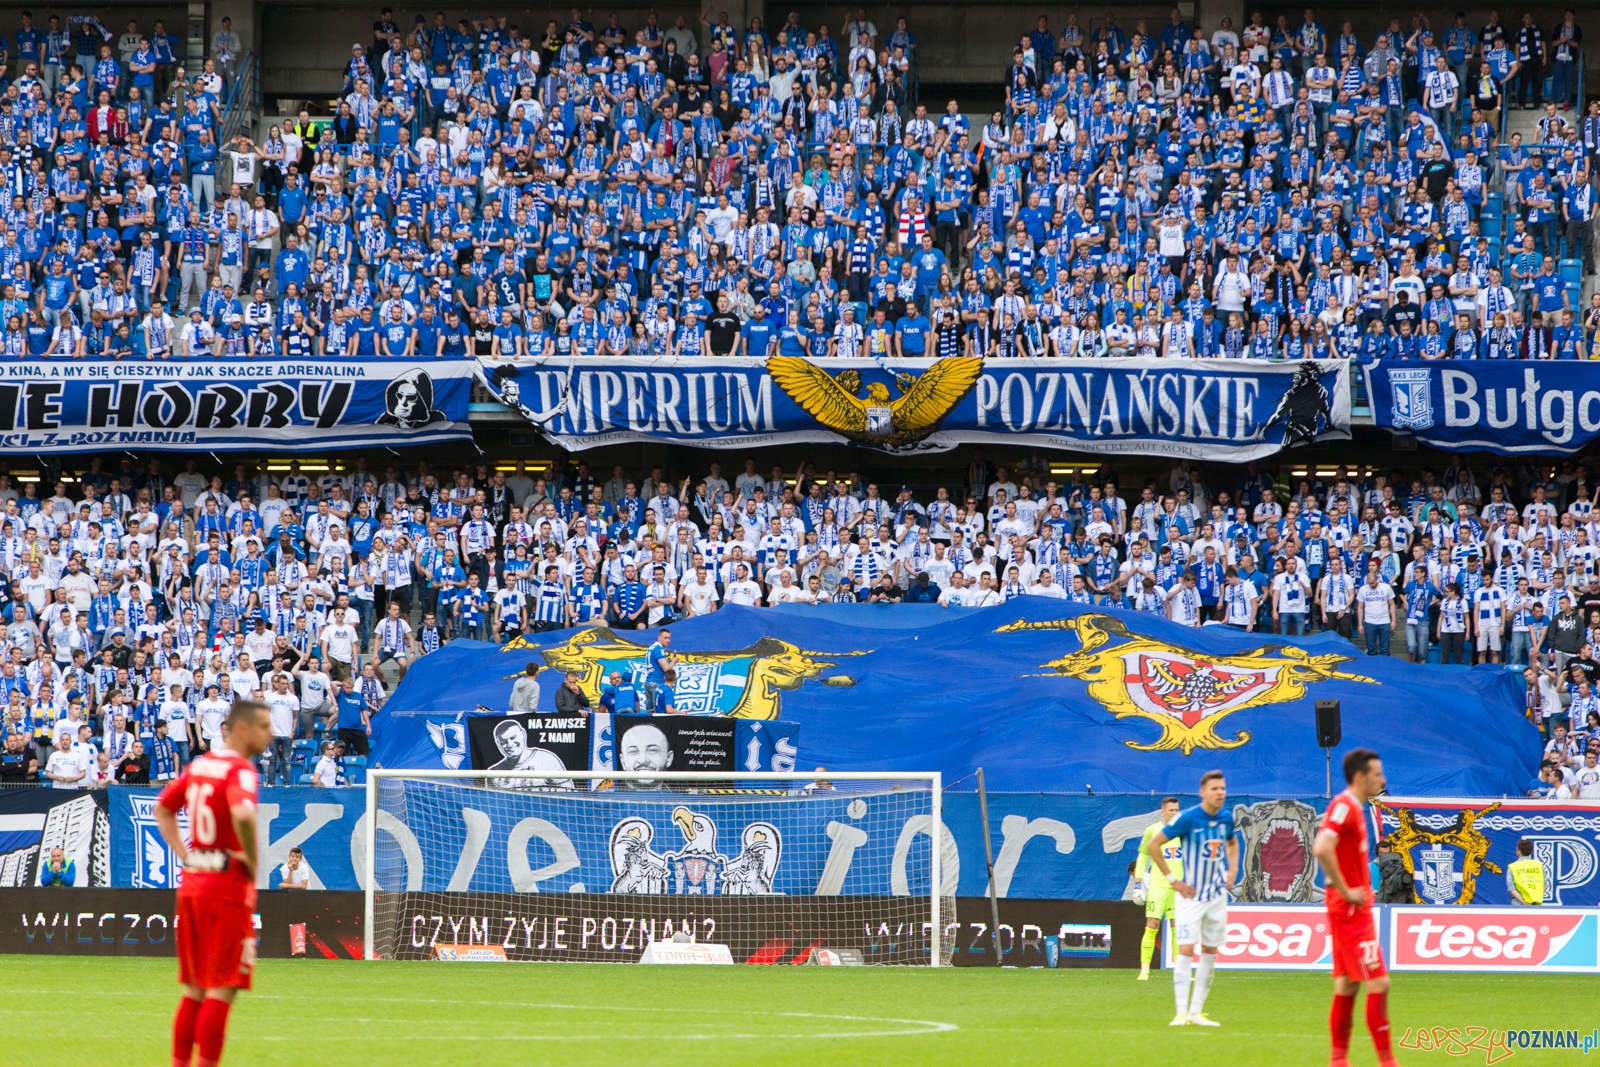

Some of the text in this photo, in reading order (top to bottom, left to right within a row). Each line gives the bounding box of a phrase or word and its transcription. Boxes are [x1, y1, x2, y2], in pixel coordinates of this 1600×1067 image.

[9, 366, 46, 378] KINA,
[50, 367, 60, 376] A
[64, 367, 84, 376] MY
[88, 366, 109, 379] SIĘ
[113, 365, 183, 376] CIESZYMY
[187, 366, 214, 376] JAK
[218, 366, 273, 377] SKACZE
[278, 365, 366, 377] ADRENALINA
[1393, 371, 1426, 379] KKS LECH
[88, 380, 355, 429] HOBBY
[535, 369, 779, 436] IMPERIUM
[976, 368, 1261, 441] POZNAŃSKIE
[41, 433, 59, 446] Z
[70, 431, 196, 444] POZNANIA
[1048, 438, 1069, 446] AUT
[1134, 443, 1158, 451] AUT
[1161, 445, 1193, 455] MORI
[528, 718, 586, 729] NA ZAWSZE
[539, 732, 576, 743] Z NAMI
[1165, 847, 1182, 860] STS
[1202, 841, 1223, 859] STS
[1516, 867, 1540, 876] STEWARD
[412, 914, 489, 948] CZYM
[503, 910, 568, 949] ŻYJE
[440, 948, 457, 960] STS
